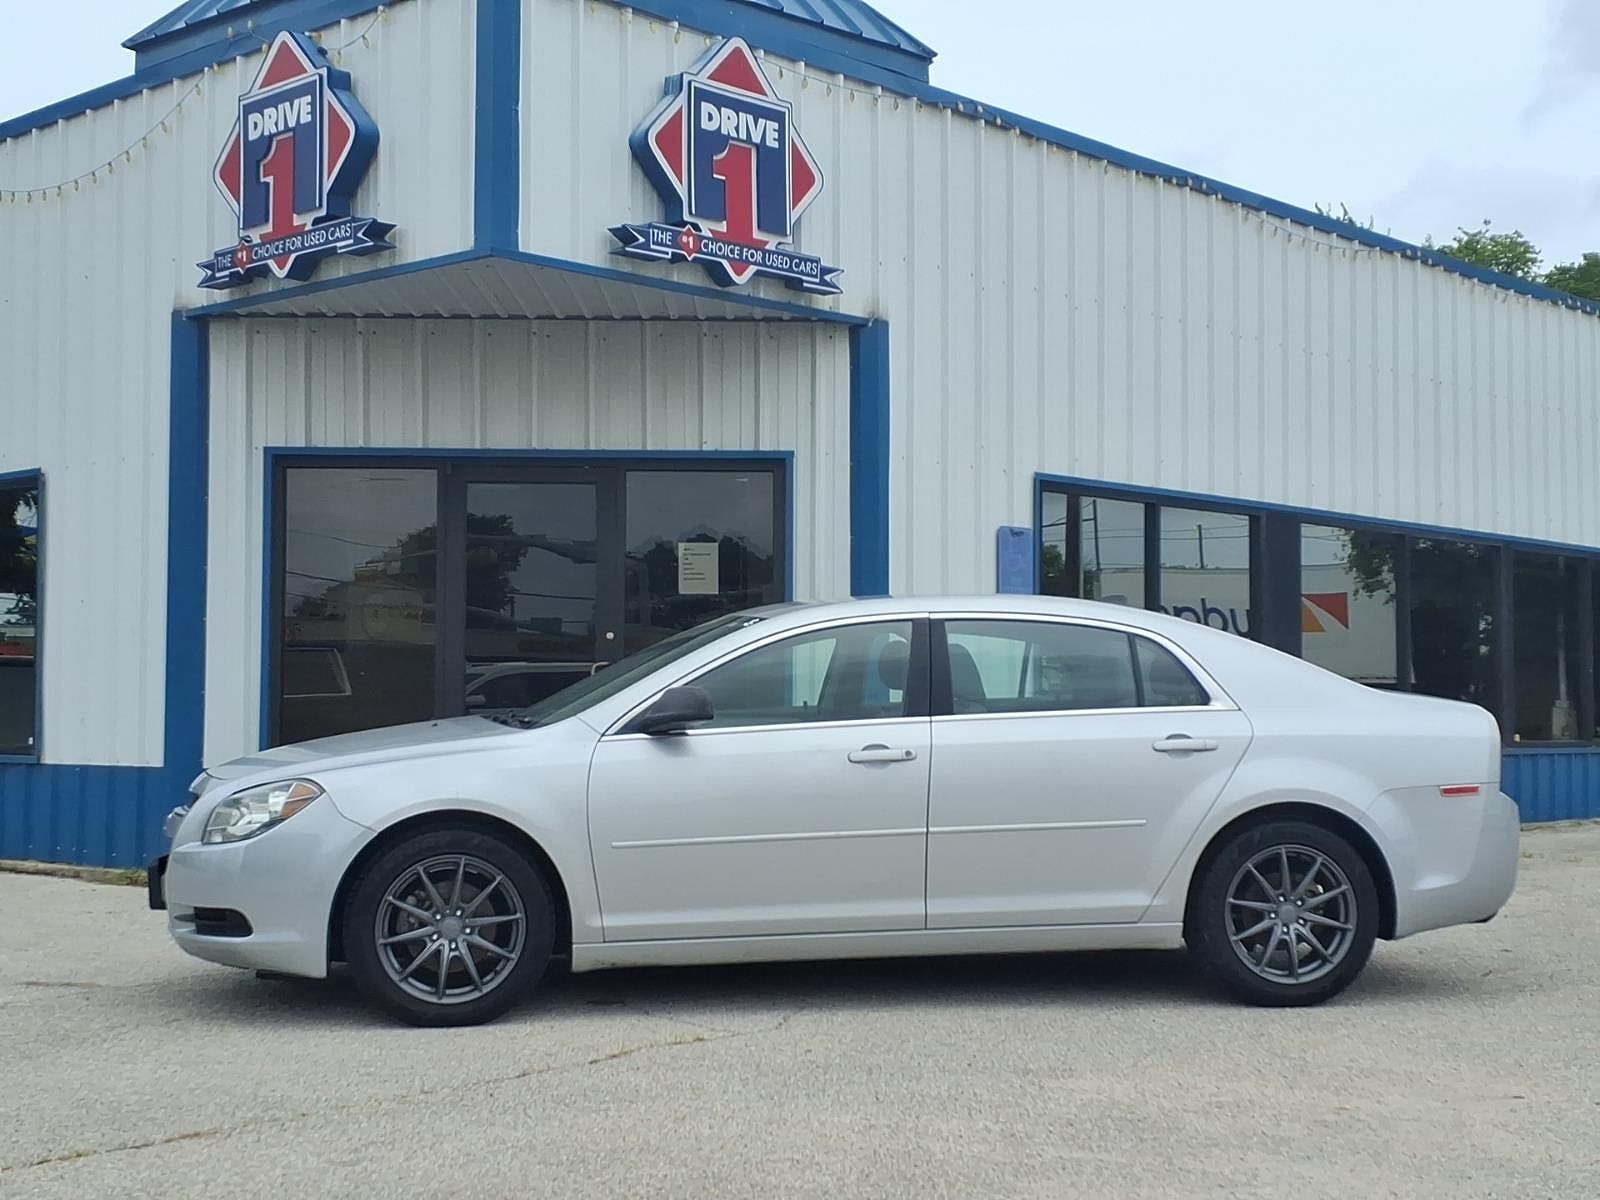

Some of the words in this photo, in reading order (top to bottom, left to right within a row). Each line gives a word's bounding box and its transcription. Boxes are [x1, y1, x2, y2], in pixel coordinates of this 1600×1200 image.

[248, 95, 312, 141] DRIVE
[701, 101, 779, 149] DRIVE
[260, 132, 308, 242] 1
[707, 139, 771, 248] 1
[217, 254, 232, 268] THE
[251, 240, 284, 260] CHOICE
[285, 236, 302, 251] FOR
[304, 230, 327, 247] USED
[328, 223, 351, 240] CARS
[653, 229, 673, 245] THE
[682, 235, 694, 249] #1
[701, 239, 740, 260] CHOICE
[742, 247, 763, 264] FOR
[765, 253, 790, 269] USED
[792, 258, 818, 275] CARS
